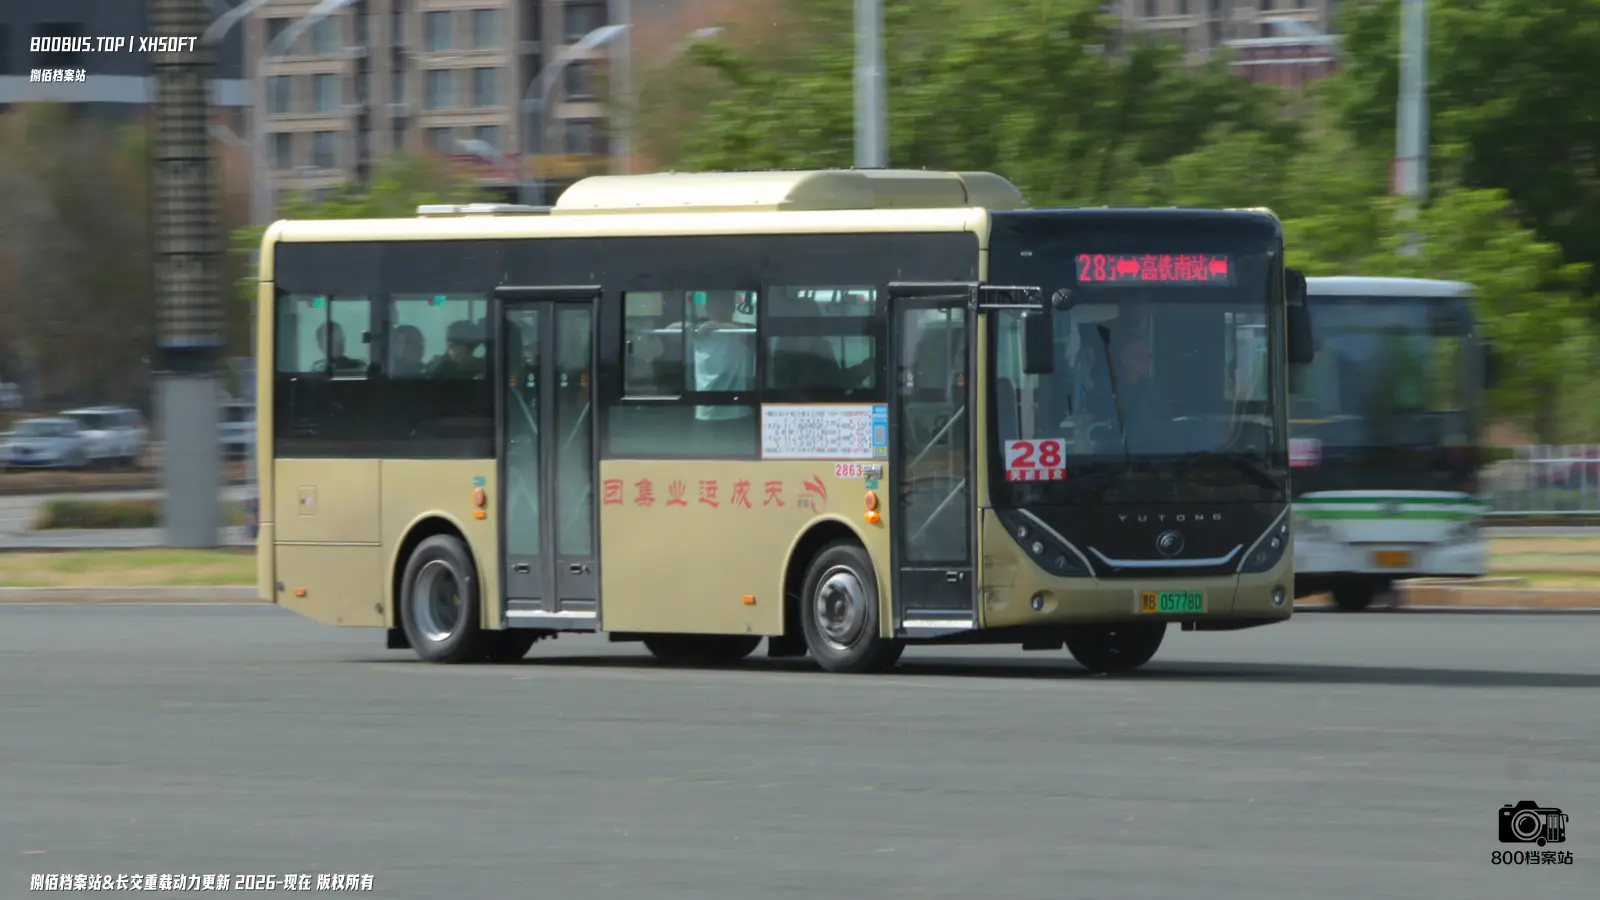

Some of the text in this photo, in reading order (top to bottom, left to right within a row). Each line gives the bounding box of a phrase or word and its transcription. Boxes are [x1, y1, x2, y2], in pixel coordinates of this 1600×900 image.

[1011, 440, 1062, 468] 28
[835, 464, 862, 477] 2863
[1118, 513, 1222, 522] YUTONG
